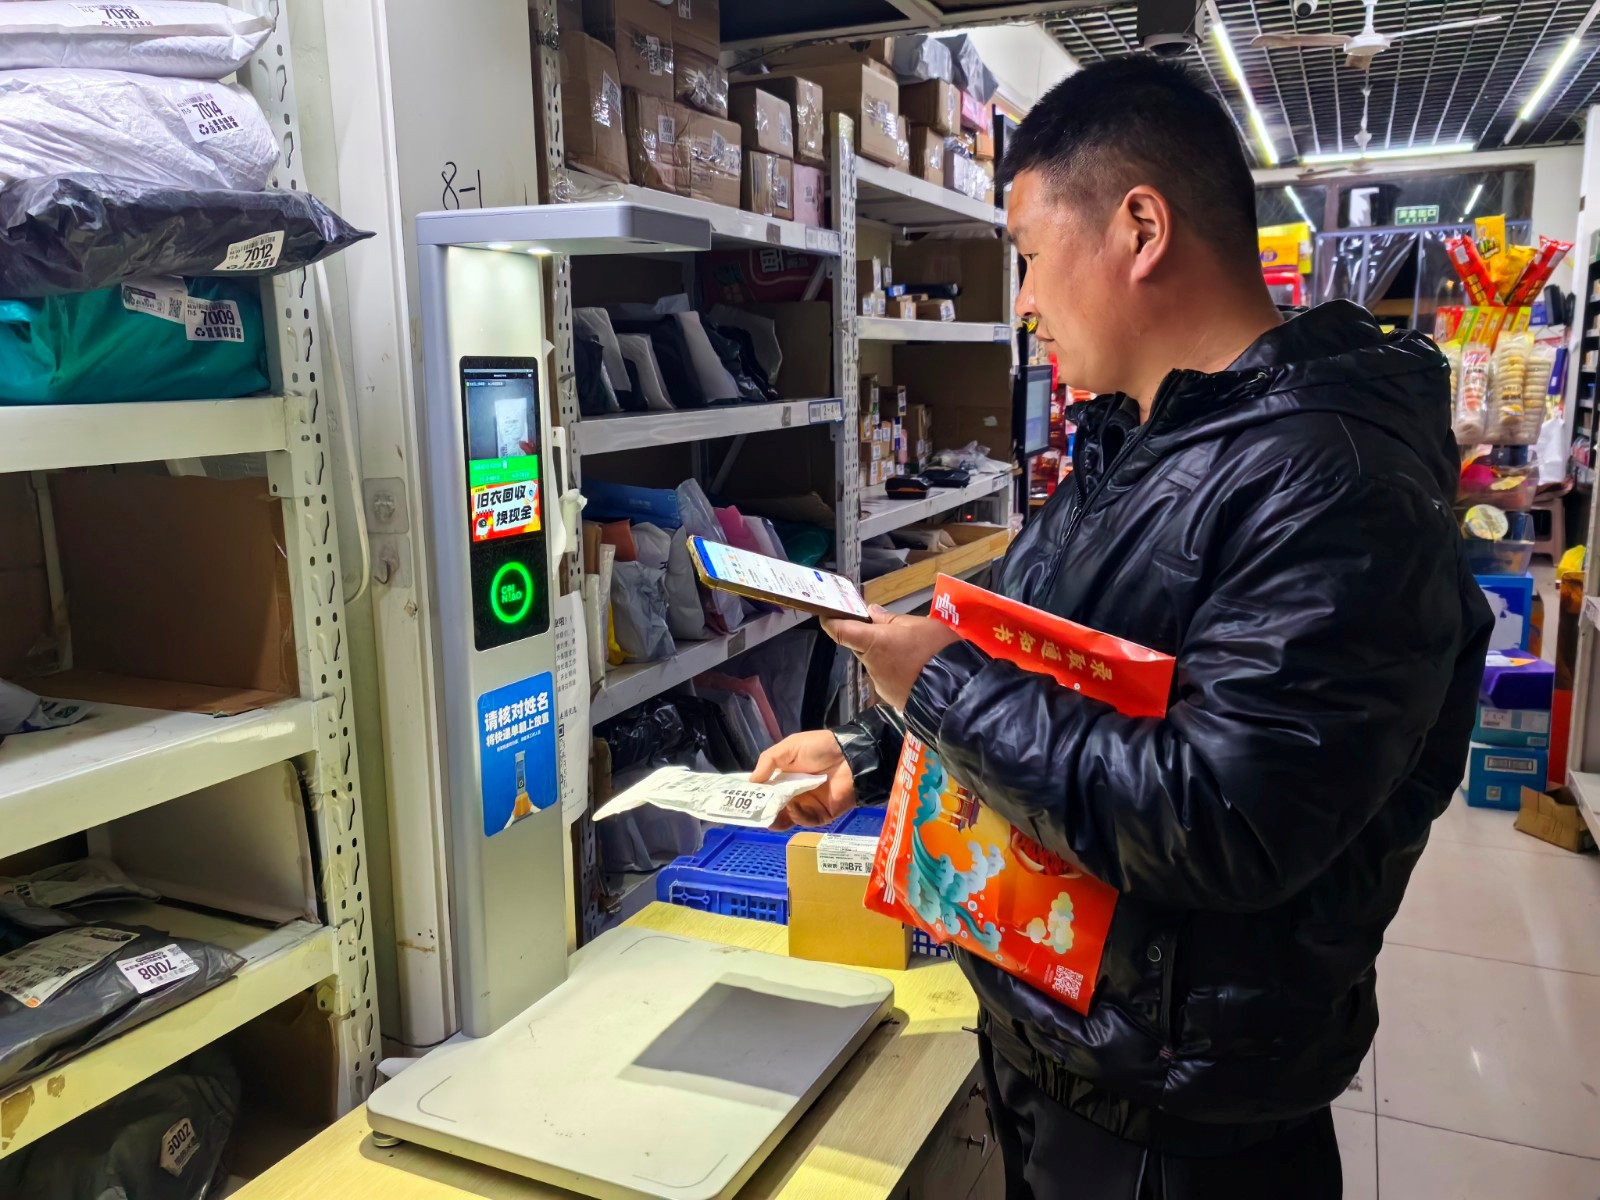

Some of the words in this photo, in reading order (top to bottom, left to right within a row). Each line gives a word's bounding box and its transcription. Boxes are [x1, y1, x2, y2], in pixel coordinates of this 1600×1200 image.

[100, 8, 140, 20] 7018
[192, 100, 224, 120] 7014
[441, 161, 483, 210] 8-1
[243, 243, 274, 263] 7012
[200, 309, 236, 326] 7009
[477, 484, 527, 509] 旧衣回收
[496, 504, 532, 527] 换现金
[992, 623, 1113, 681] 录取通知书
[484, 691, 549, 732] 请核对姓名
[138, 959, 178, 980] 7008
